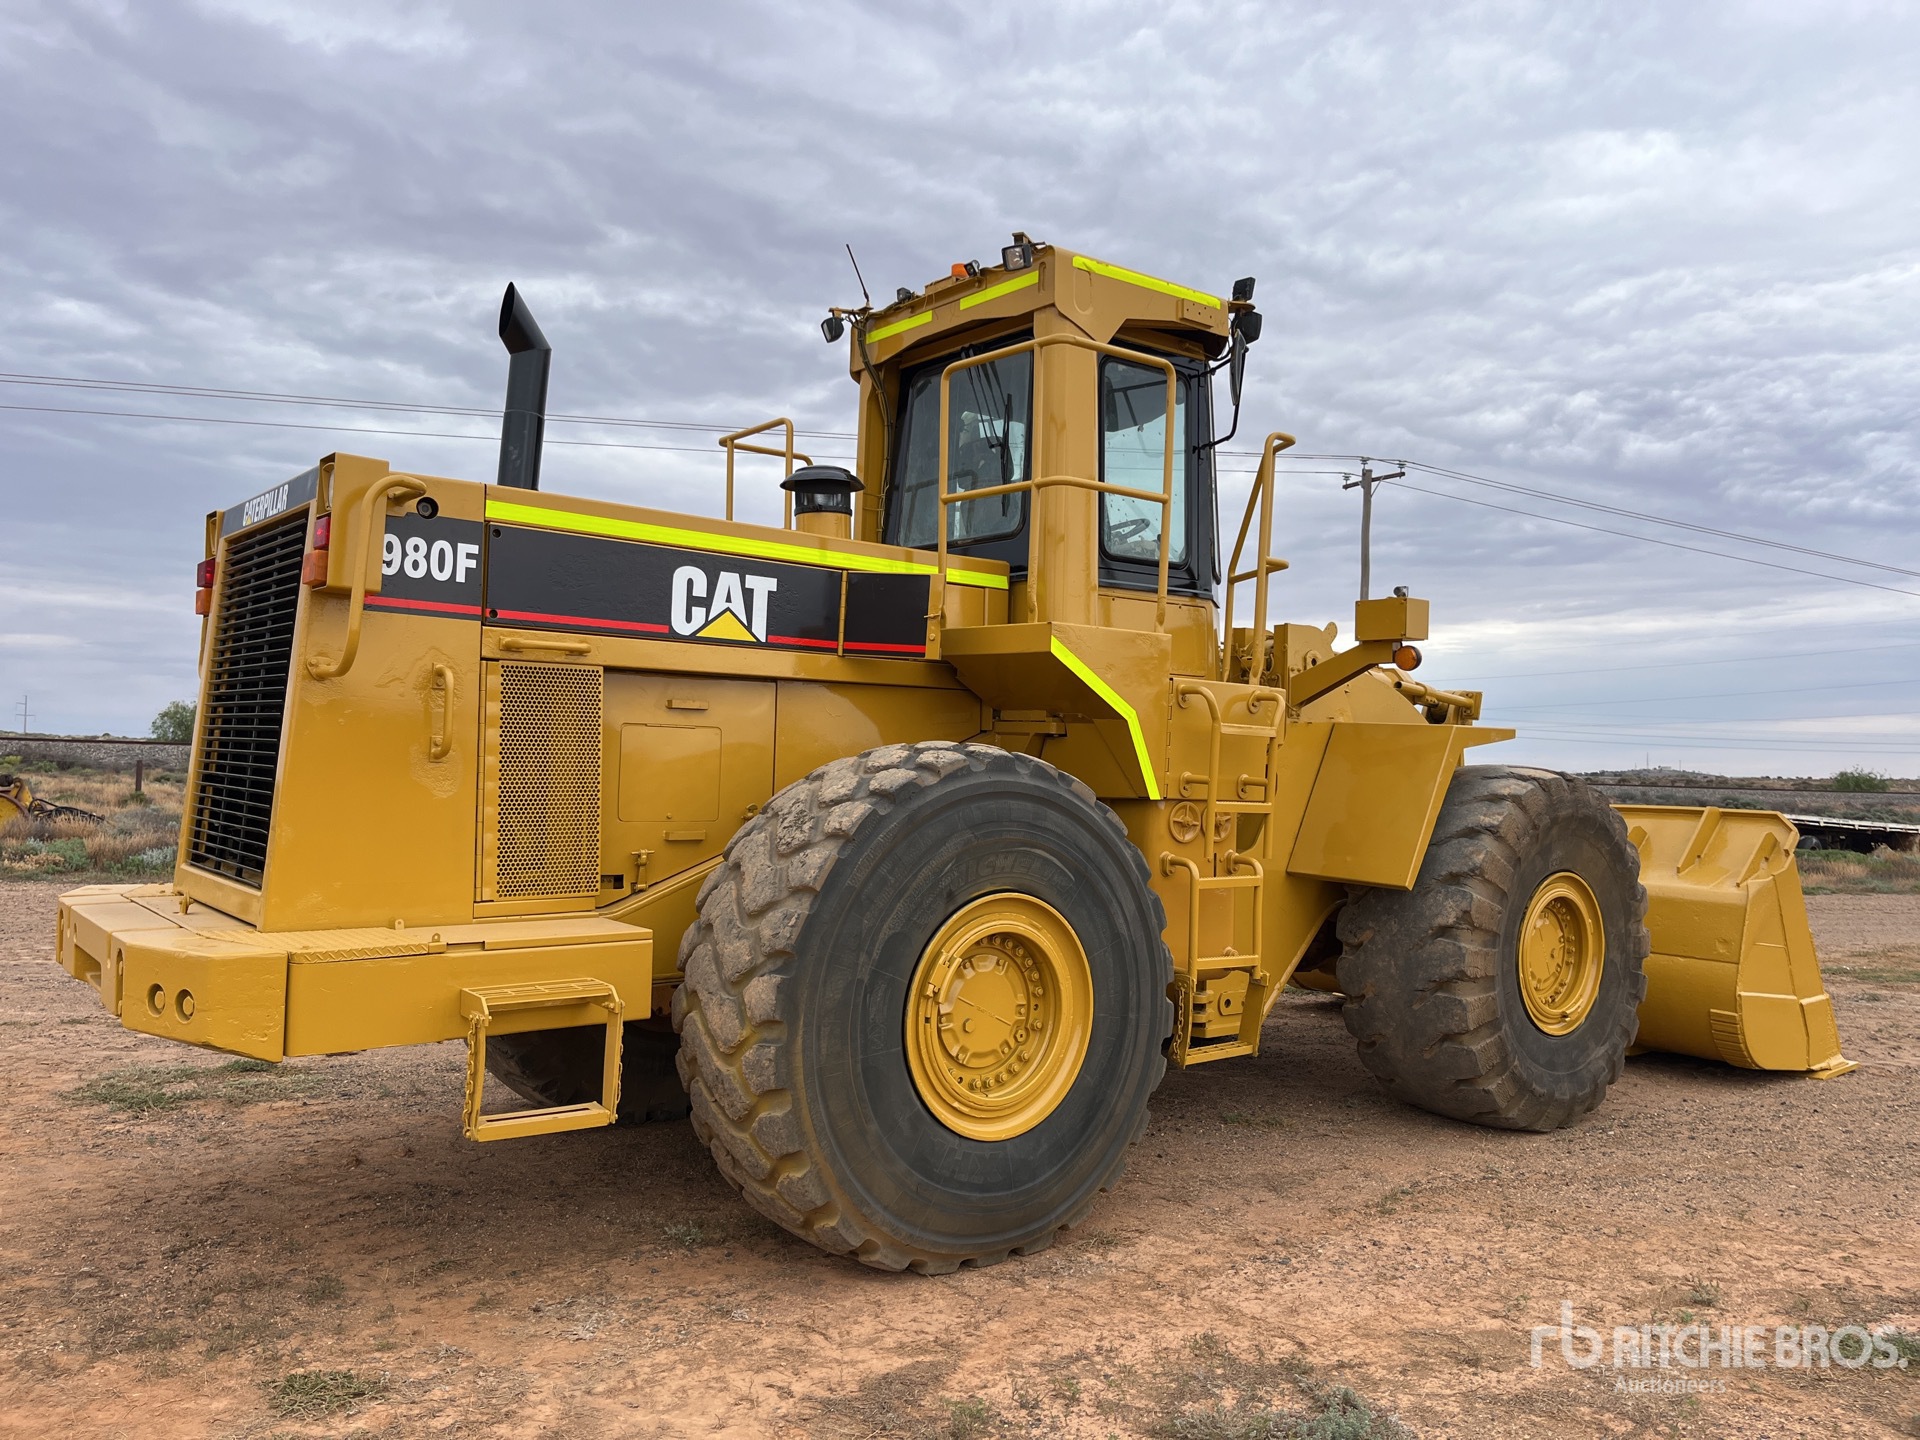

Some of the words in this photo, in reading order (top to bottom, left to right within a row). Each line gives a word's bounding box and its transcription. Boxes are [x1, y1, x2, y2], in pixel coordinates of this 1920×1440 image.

[242, 483, 289, 527] CATERPILLAR
[381, 533, 479, 583] 980F
[671, 565, 778, 643] CAT
